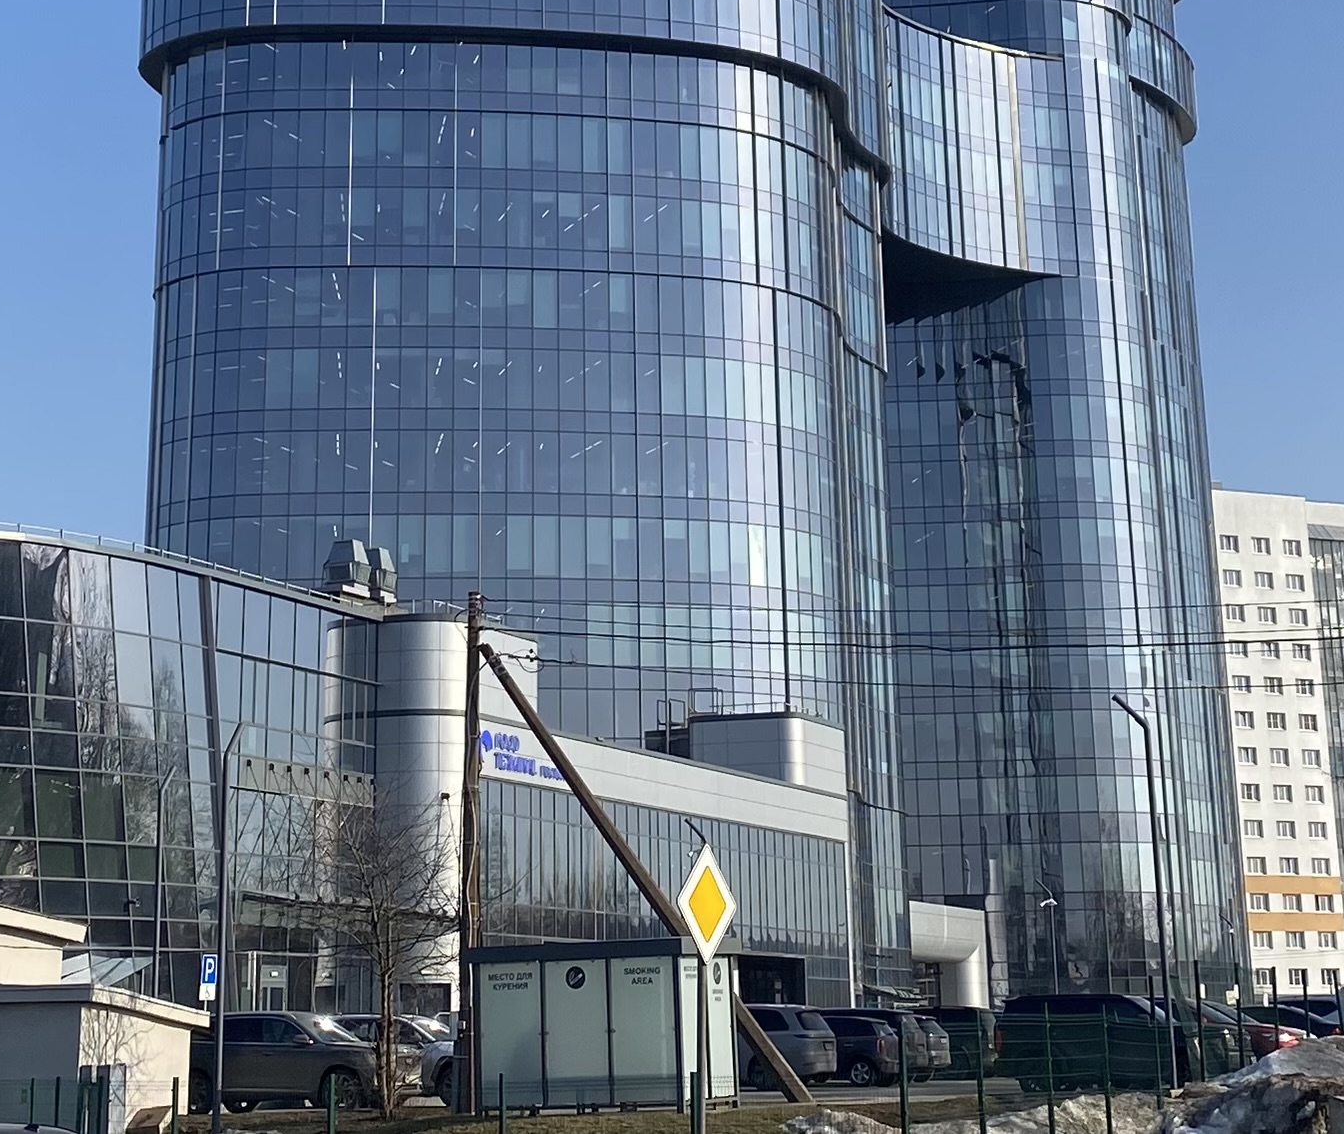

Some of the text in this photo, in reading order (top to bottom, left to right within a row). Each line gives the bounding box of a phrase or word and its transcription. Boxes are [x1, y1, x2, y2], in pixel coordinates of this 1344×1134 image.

[204, 957, 215, 982] P
[623, 967, 661, 975] SMOKING
[488, 972, 533, 981] МЕСТО ДЛЯ
[631, 977, 654, 985] AREA
[492, 982, 529, 991] КУРЕНИЯ
